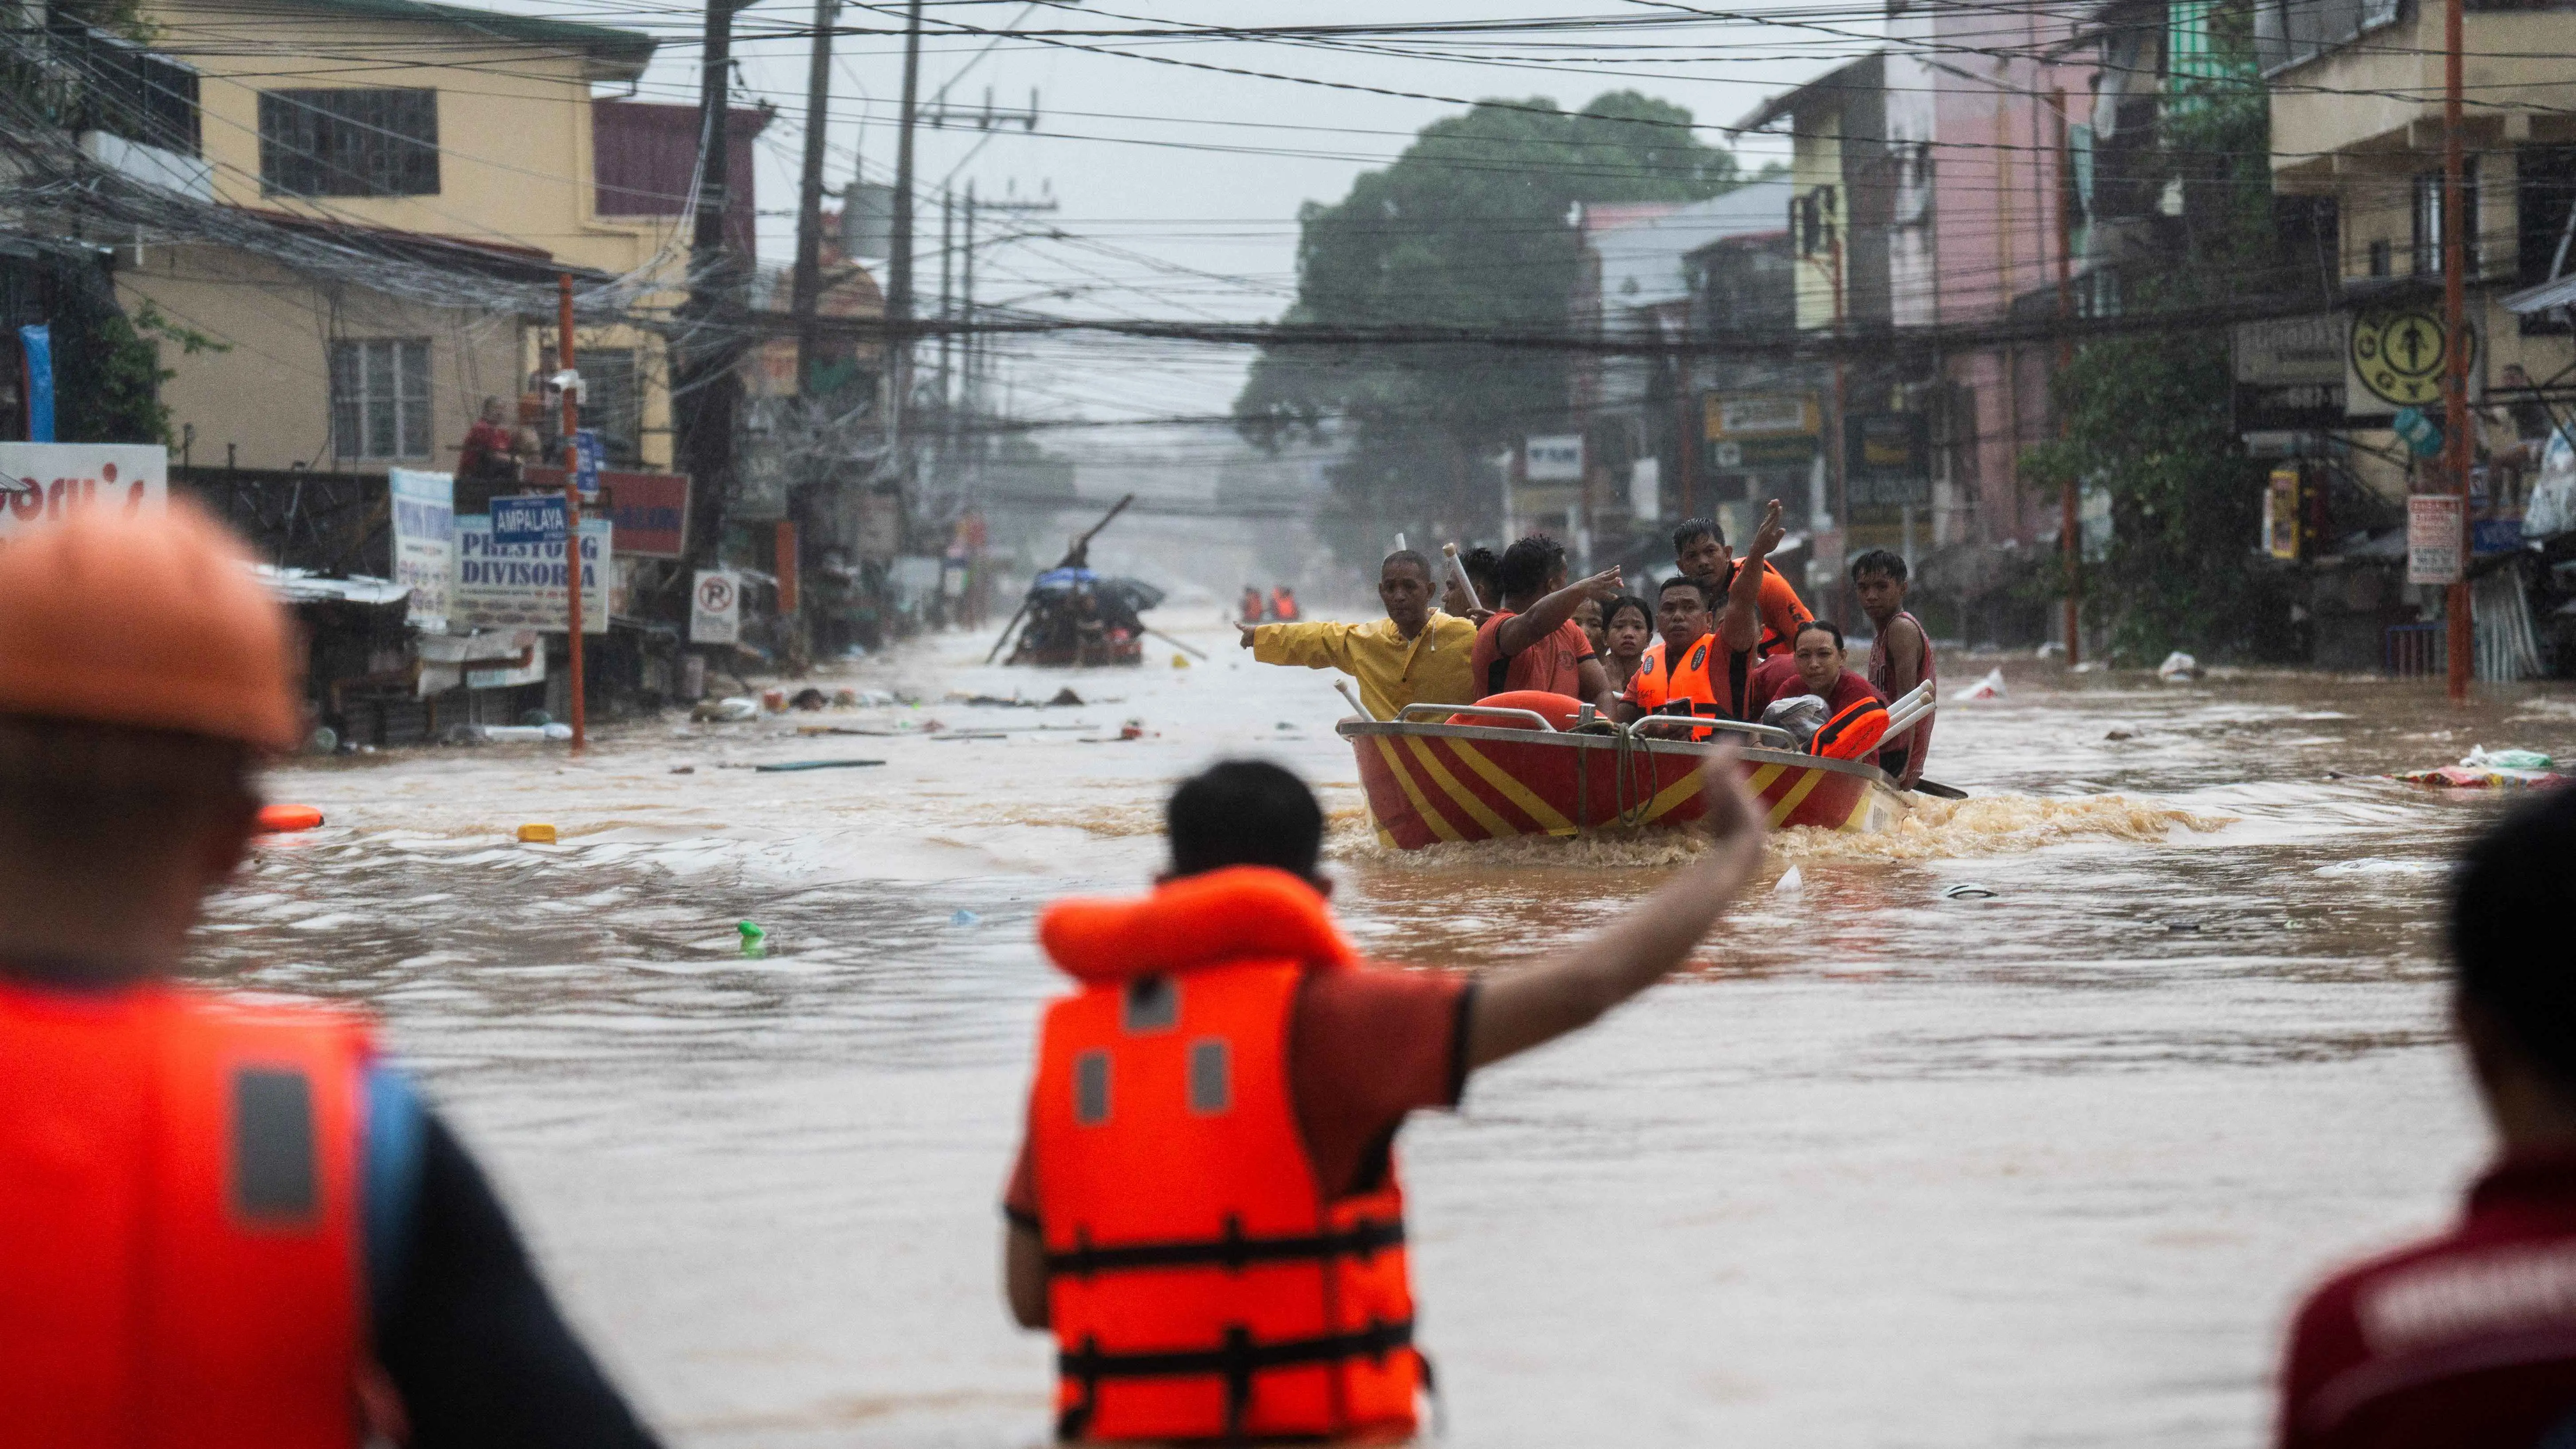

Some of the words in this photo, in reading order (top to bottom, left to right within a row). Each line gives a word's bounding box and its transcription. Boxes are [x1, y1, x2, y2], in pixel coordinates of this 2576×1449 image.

[497, 507, 564, 532] AMPALAYA
[462, 532, 598, 560] PRESTOG
[462, 560, 595, 587] DIVISORA
